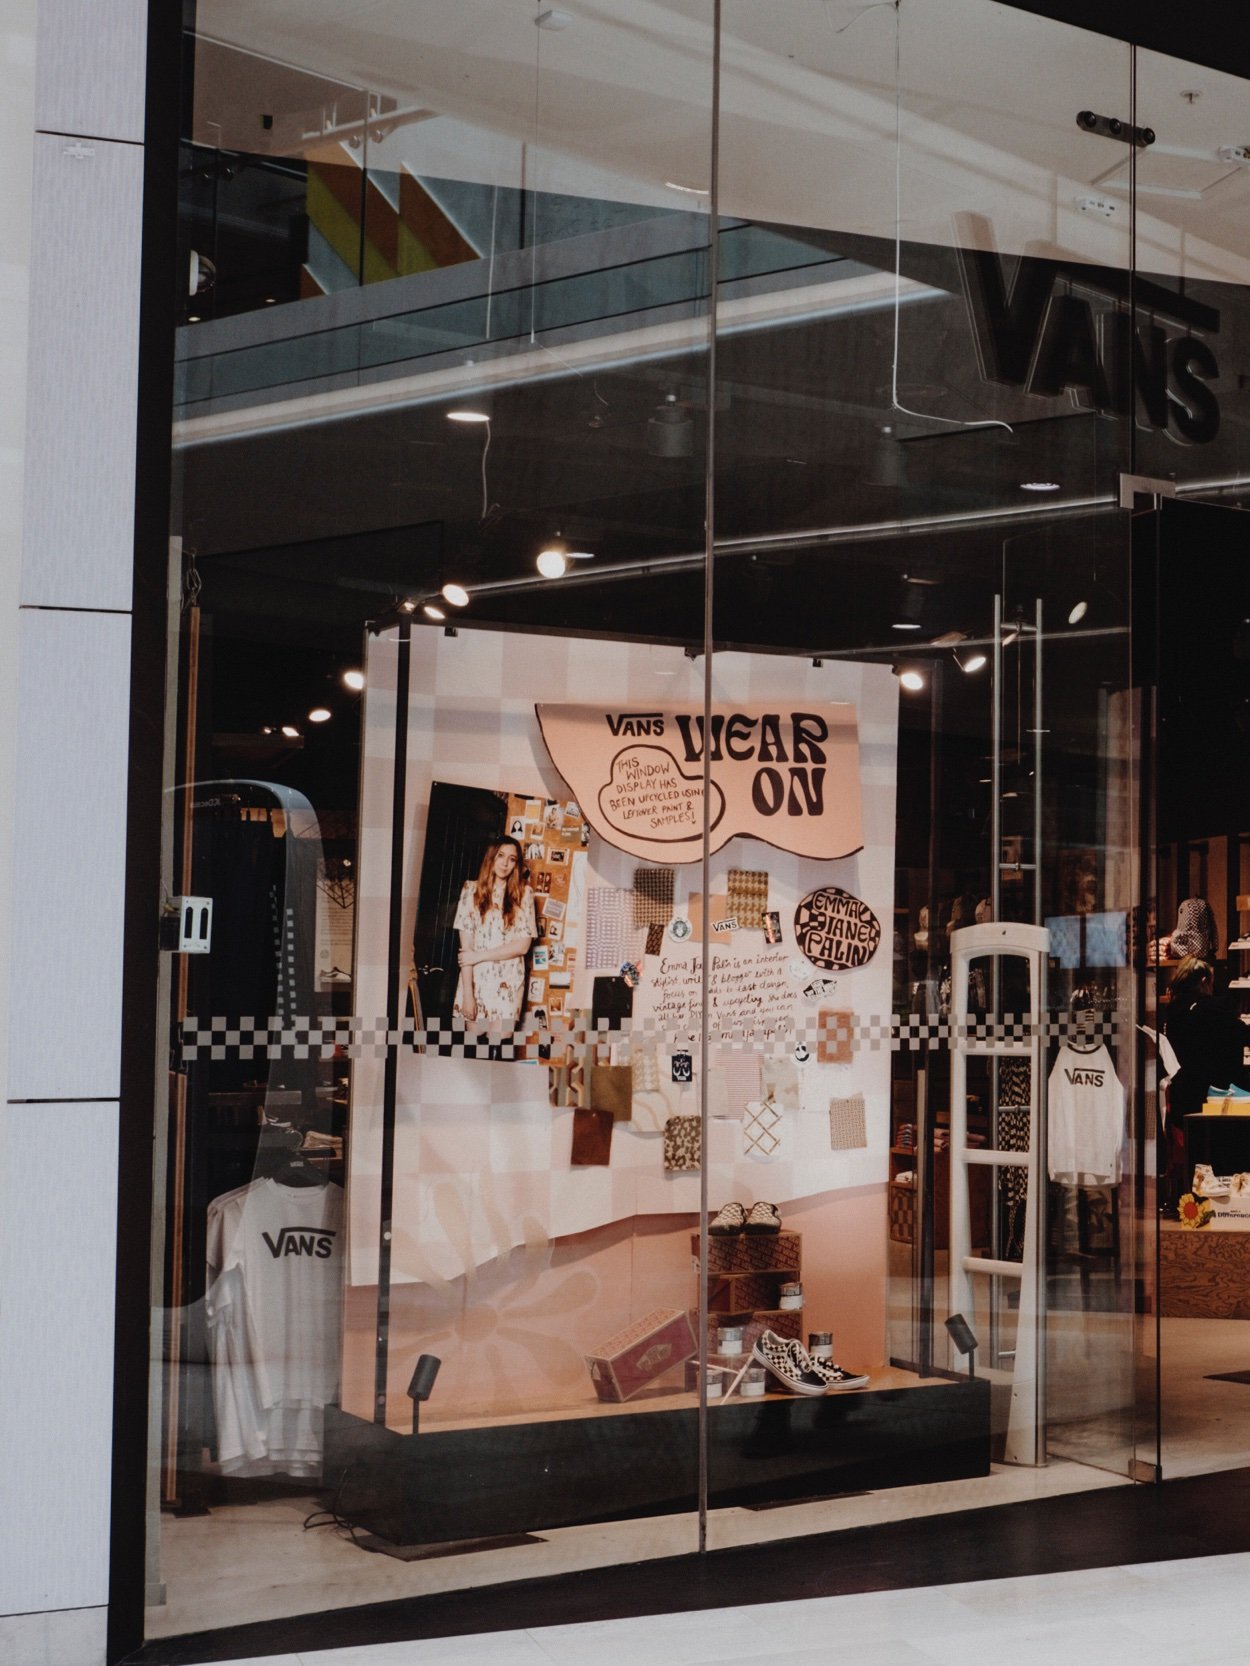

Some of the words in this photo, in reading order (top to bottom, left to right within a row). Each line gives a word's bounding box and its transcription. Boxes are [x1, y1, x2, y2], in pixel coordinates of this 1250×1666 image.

[953, 211, 1221, 446] VANS
[606, 712, 664, 737] VANS
[675, 712, 829, 764] WEAR
[616, 757, 639, 773] THIS
[626, 762, 670, 780] WINDOW
[616, 779, 657, 794] DISPLAY
[660, 778, 677, 789] HAS
[752, 767, 826, 816] ON
[609, 797, 635, 811] BEEN
[638, 791, 679, 804] UPCYCLED
[662, 802, 682, 814] PAINT
[687, 801, 693, 810] &
[650, 811, 696, 829] SAMPLES!
[814, 895, 860, 918] EMMA
[712, 918, 738, 932] VANS
[825, 914, 869, 943] JANE
[806, 932, 868, 966] PALIN
[660, 957, 688, 974] Emma
[690, 957, 703, 974] Ja
[712, 956, 731, 971] Palin
[733, 957, 741, 969] is
[1064, 1068, 1105, 1087] VANS
[262, 1226, 337, 1259] VANS
